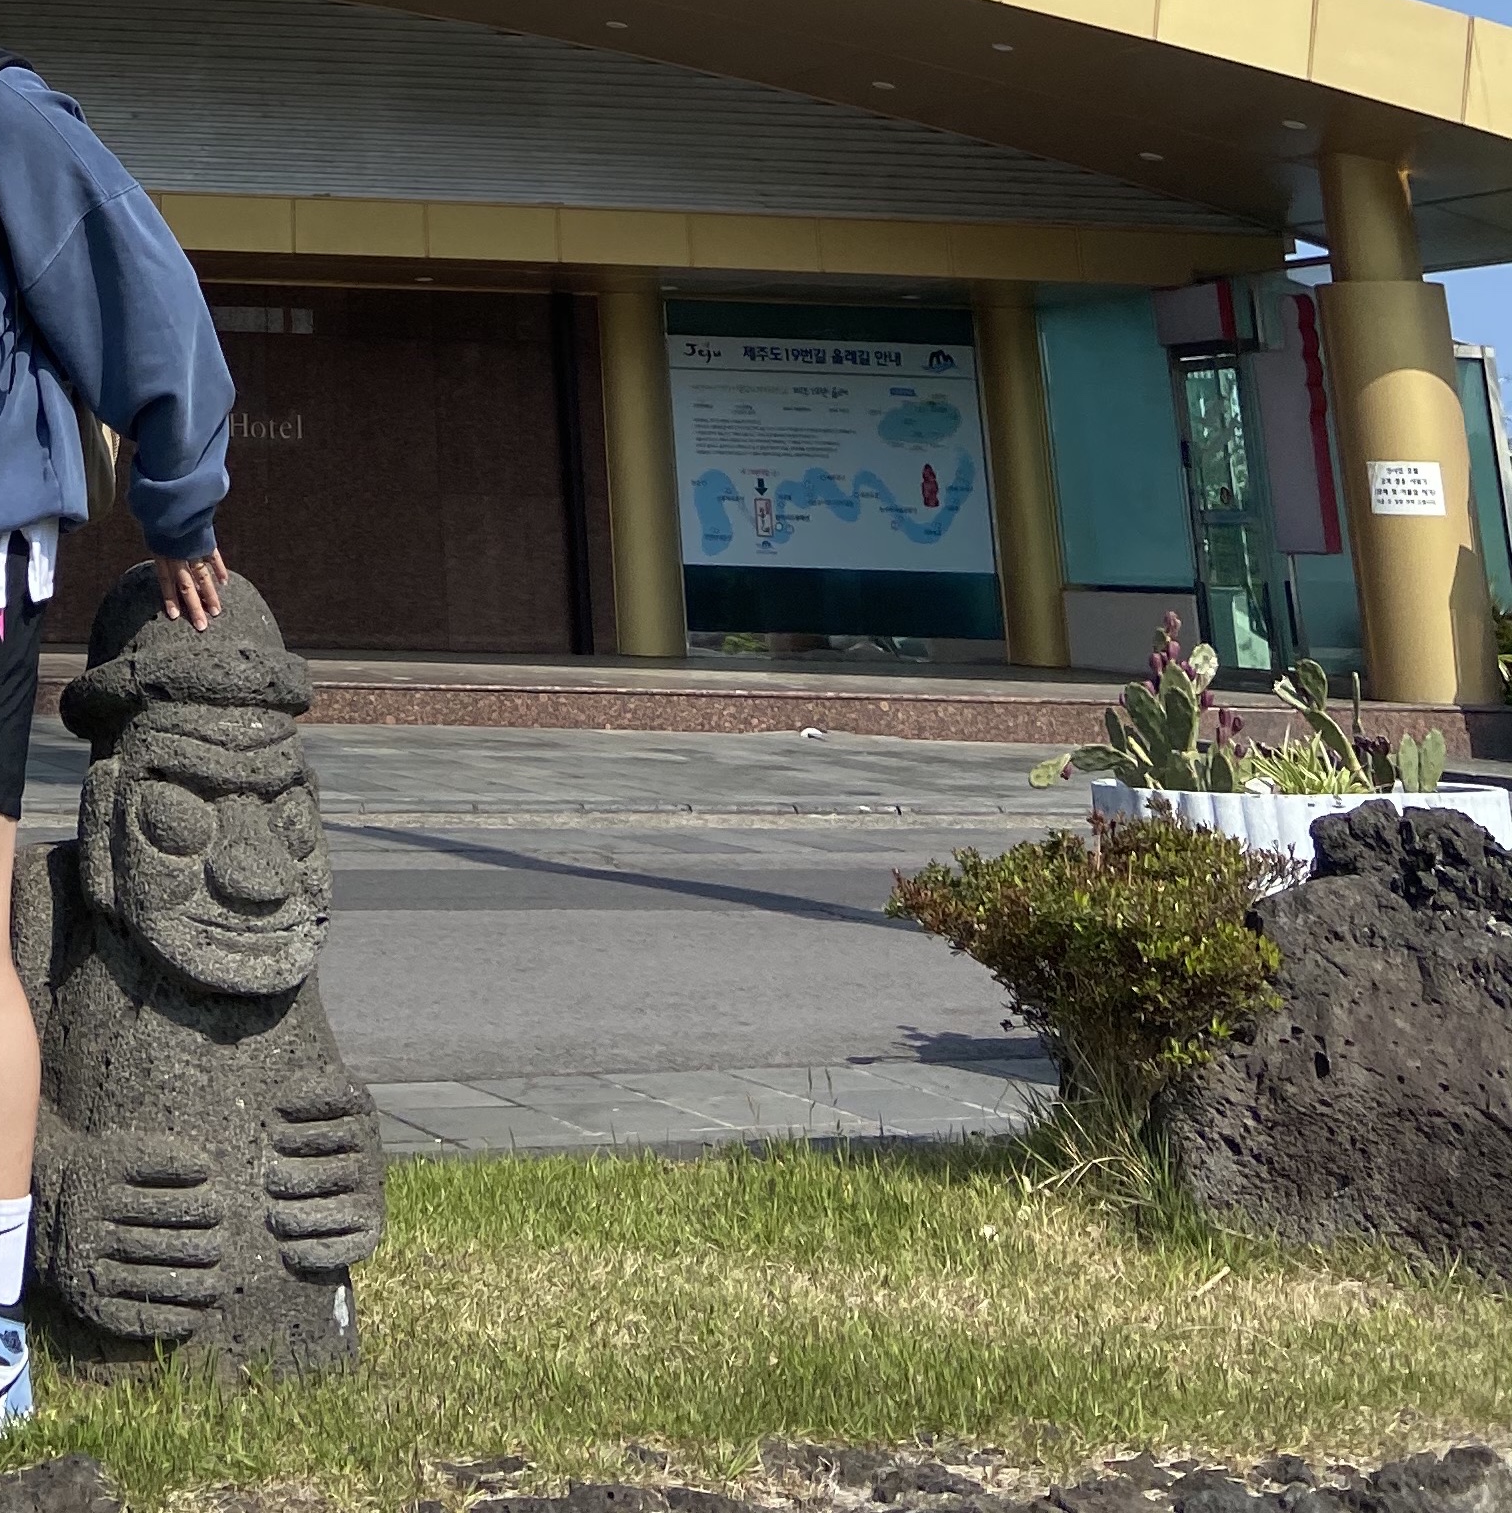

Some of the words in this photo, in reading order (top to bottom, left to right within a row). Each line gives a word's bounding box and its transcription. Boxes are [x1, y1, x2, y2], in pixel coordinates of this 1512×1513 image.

[682, 342, 722, 364] Jeju
[874, 350, 903, 368] 안내
[230, 413, 303, 439] Hotel
